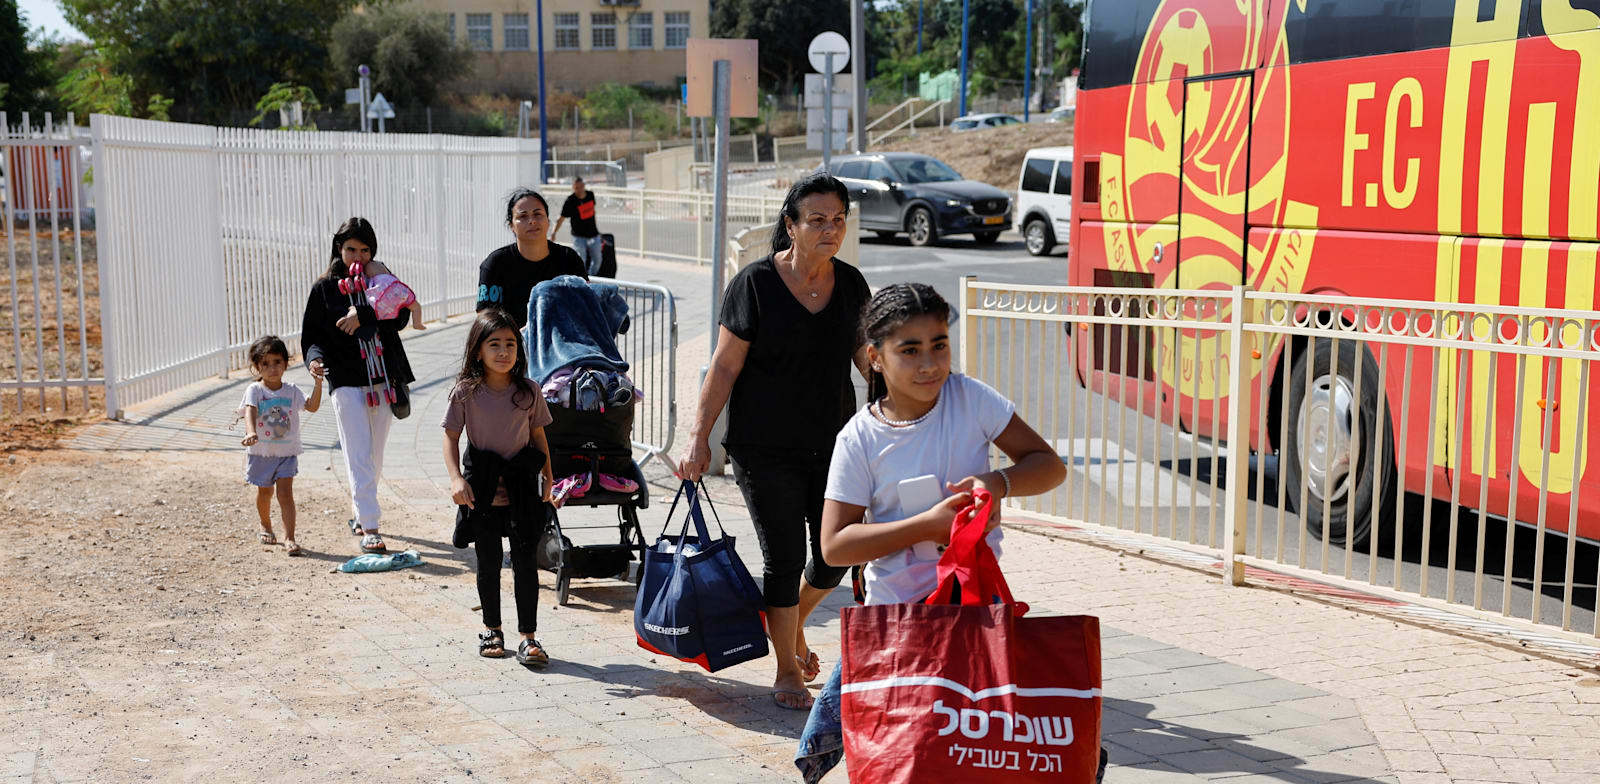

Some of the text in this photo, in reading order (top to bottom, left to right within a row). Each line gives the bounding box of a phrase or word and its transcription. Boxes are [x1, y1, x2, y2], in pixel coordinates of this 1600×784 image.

[1341, 77, 1424, 209] F.C
[643, 622, 691, 636] SKECHERS
[722, 643, 753, 656] SKECHERS
[932, 699, 1075, 746] שופרסל
[948, 743, 1063, 773] הכל בשבילי
